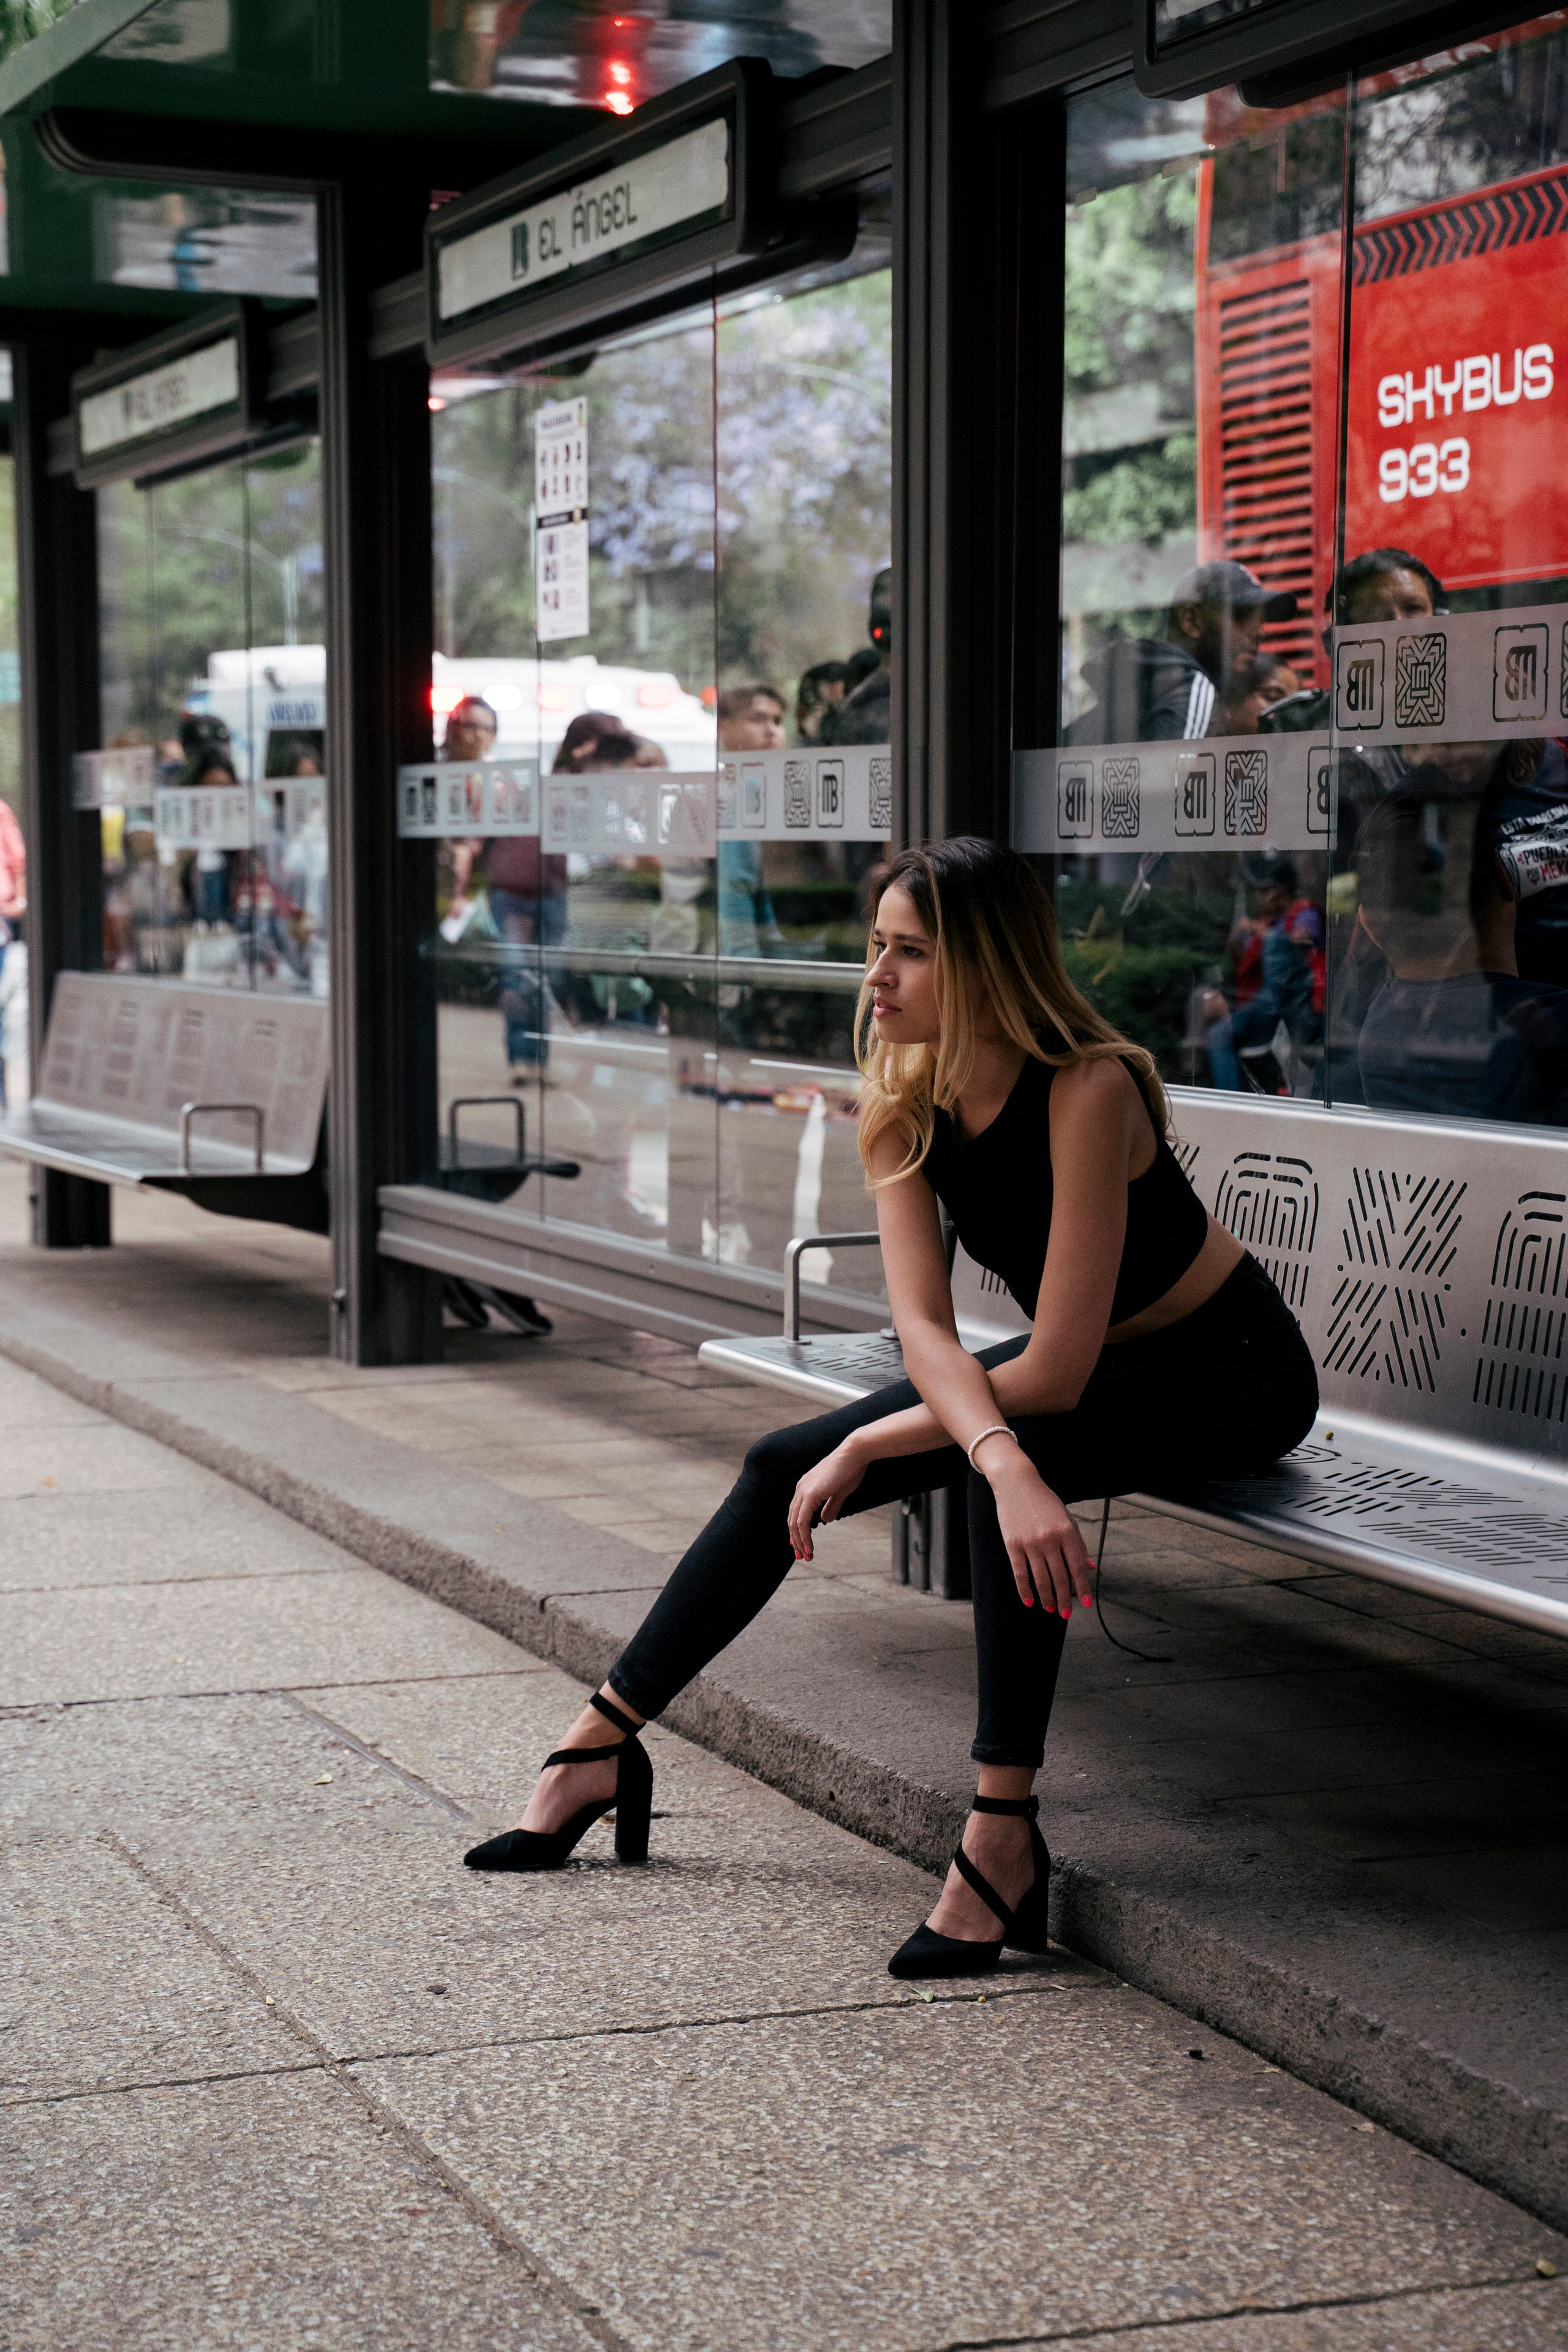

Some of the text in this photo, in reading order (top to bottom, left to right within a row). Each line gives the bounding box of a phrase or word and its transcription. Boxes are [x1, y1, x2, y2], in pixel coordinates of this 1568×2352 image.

[538, 181, 638, 262] EL ÁNGEL
[1378, 343, 1554, 428] SKYBUS
[1379, 437, 1470, 503] 933
[1501, 817, 1525, 835] ESTA
